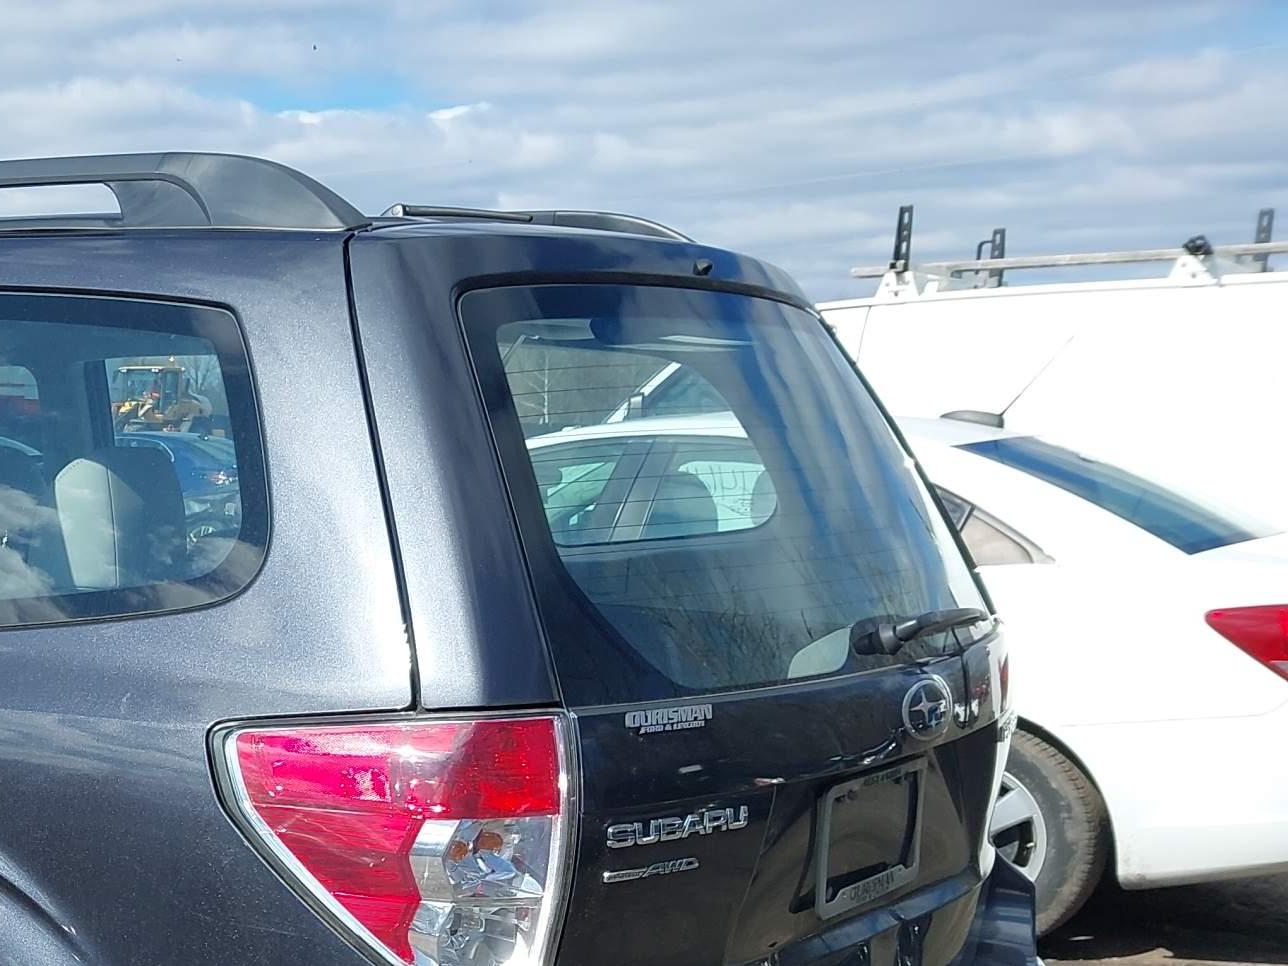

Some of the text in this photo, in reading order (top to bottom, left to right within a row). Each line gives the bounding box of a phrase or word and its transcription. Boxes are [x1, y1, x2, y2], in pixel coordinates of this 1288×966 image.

[625, 704, 713, 728] OURISMAN
[606, 805, 749, 848] SUBARU
[643, 857, 700, 877] AWD
